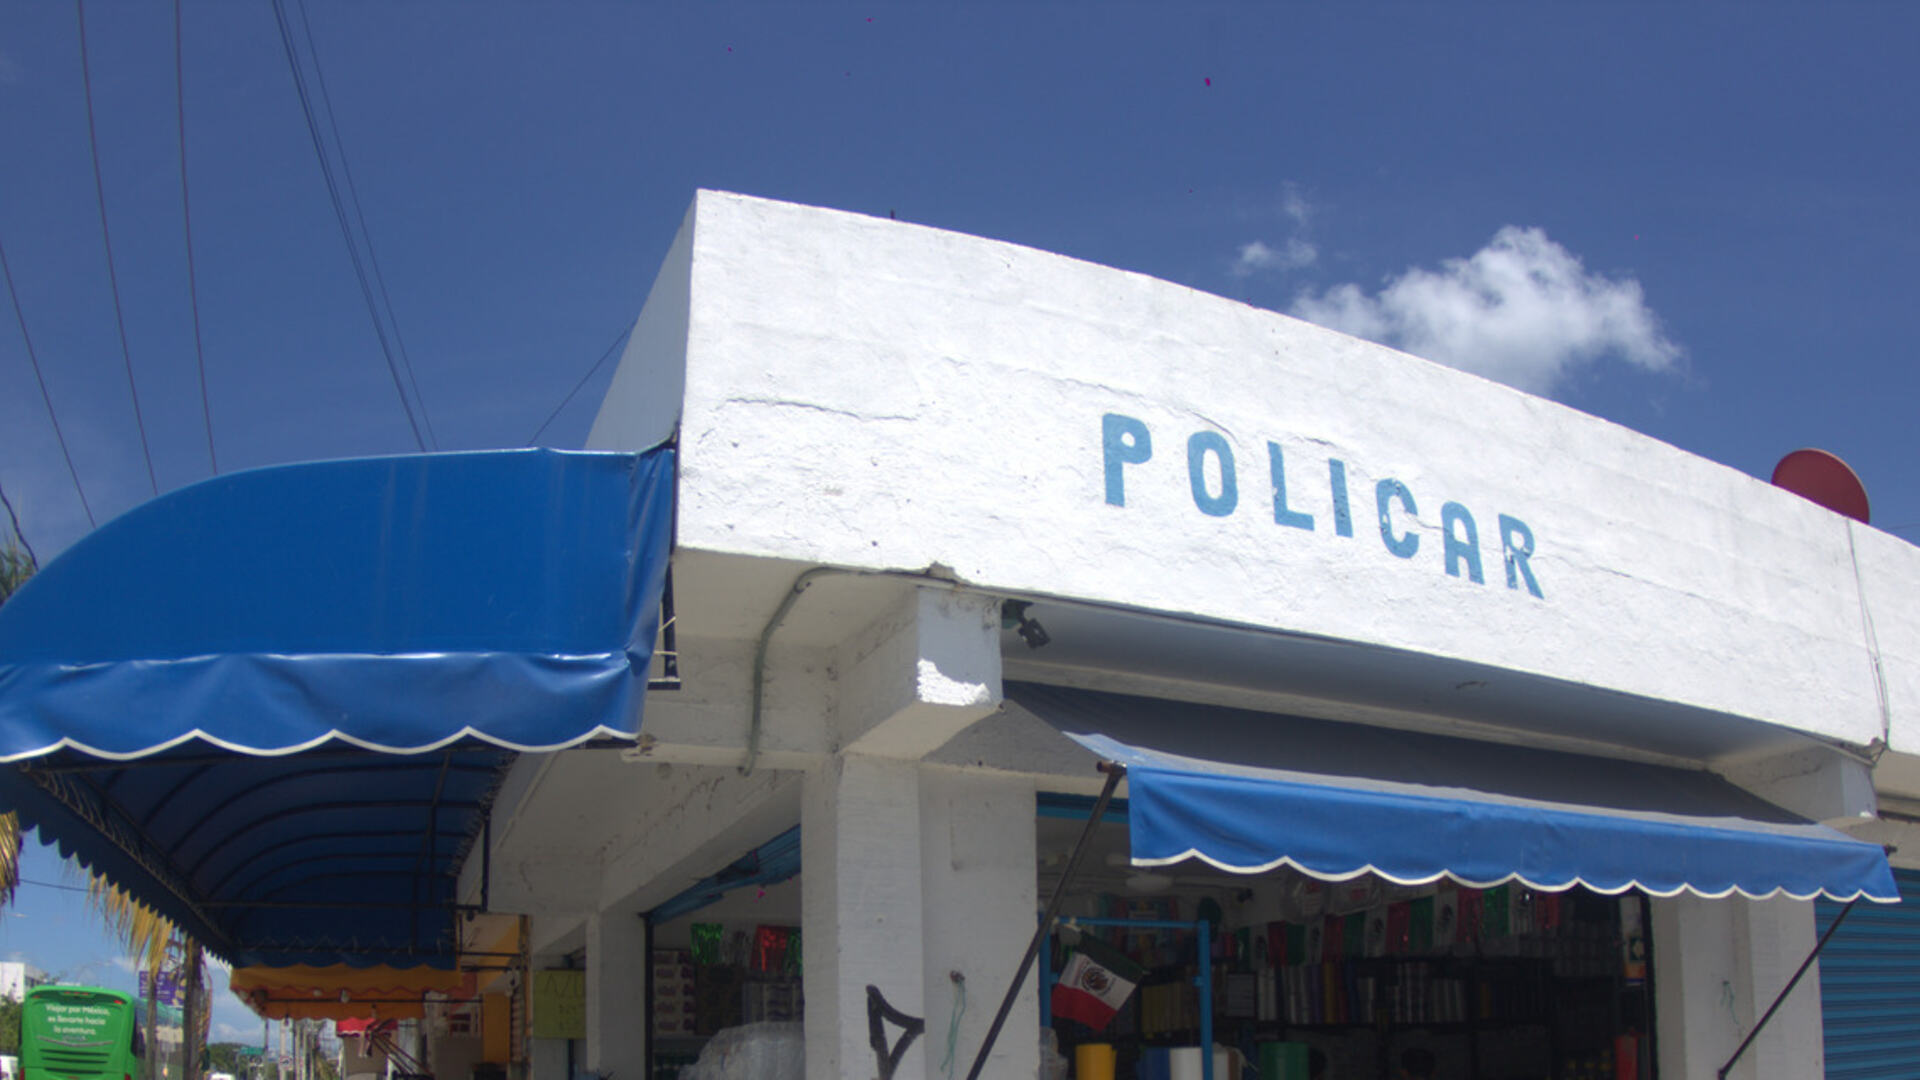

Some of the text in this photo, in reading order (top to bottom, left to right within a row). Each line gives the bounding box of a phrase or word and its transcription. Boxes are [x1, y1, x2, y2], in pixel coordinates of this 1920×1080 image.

[1101, 412, 1545, 600] POLICAR
[68, 1006, 80, 1014] por
[84, 1016, 106, 1025] hacia
